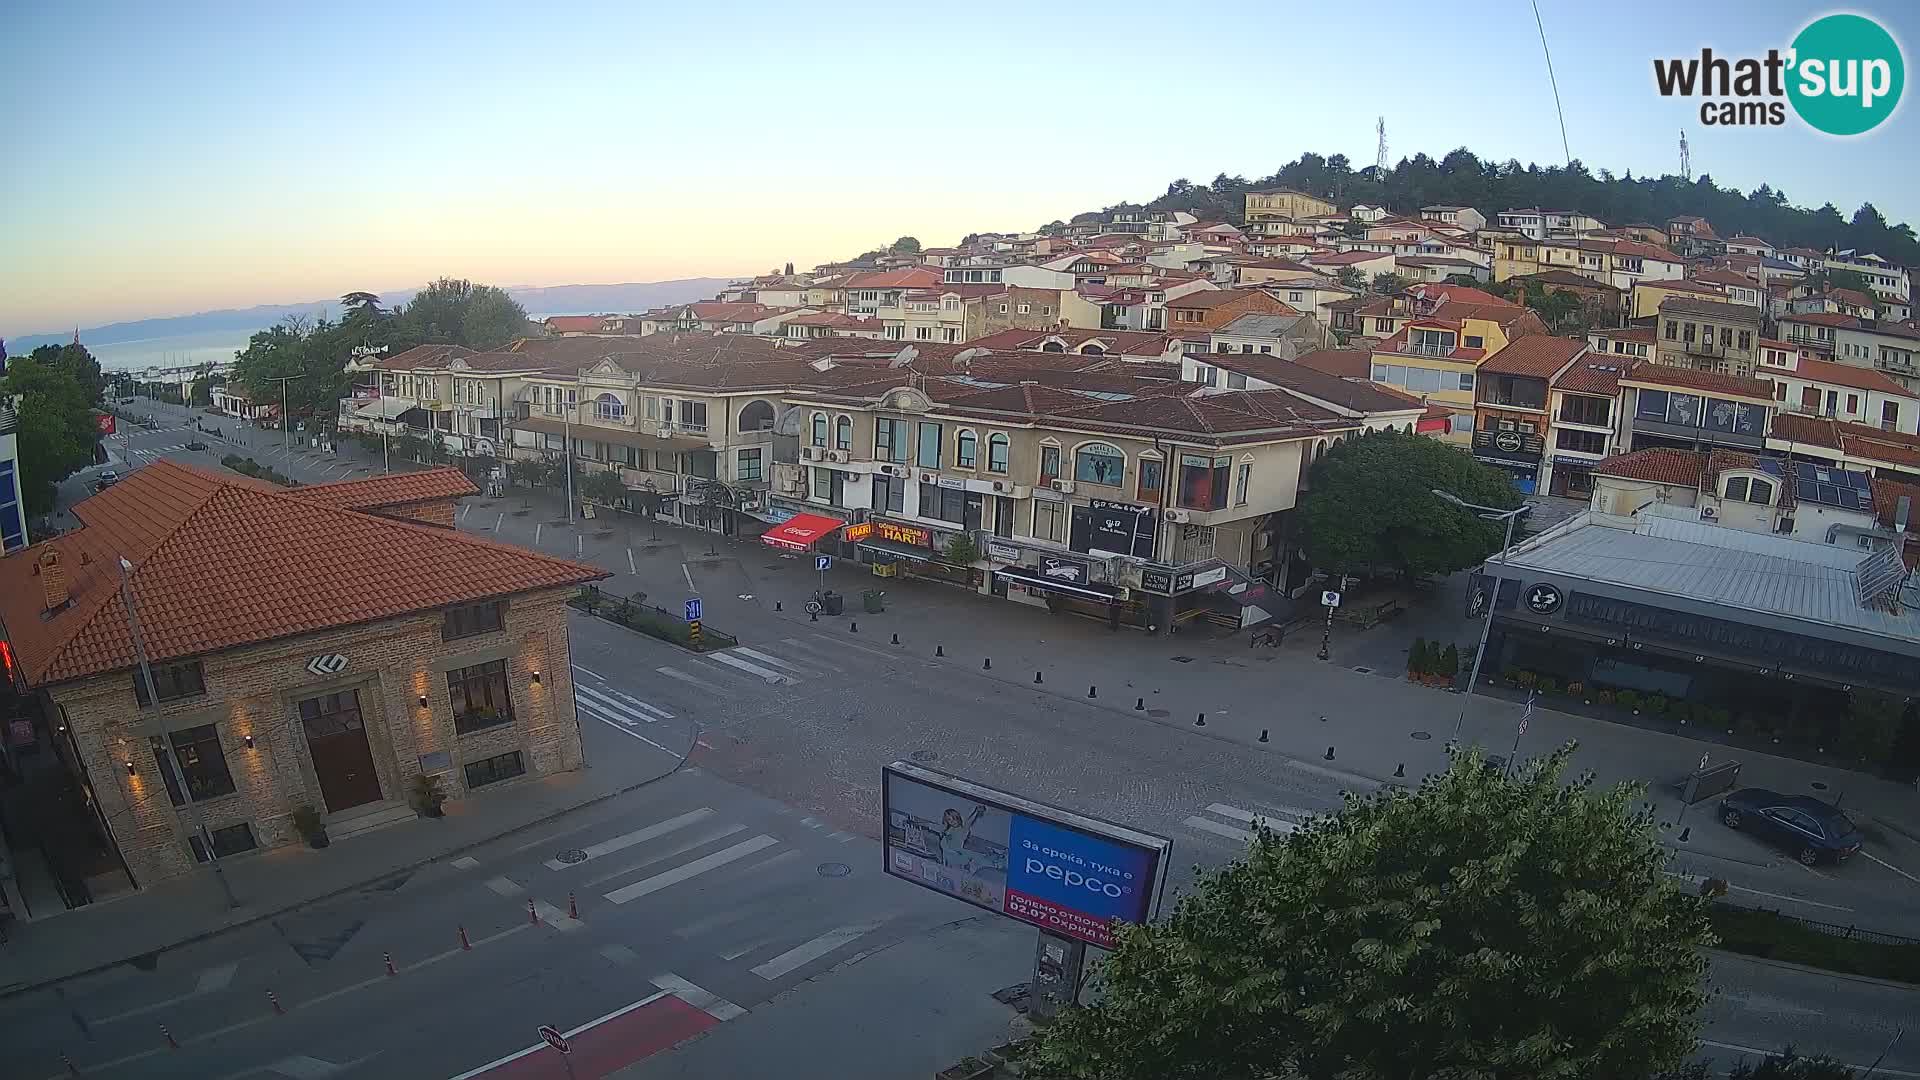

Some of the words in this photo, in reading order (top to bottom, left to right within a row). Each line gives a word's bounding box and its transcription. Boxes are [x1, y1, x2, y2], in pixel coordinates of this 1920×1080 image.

[884, 529, 916, 545] HARI
[820, 558, 827, 568] P
[1022, 840, 1039, 851] За
[1090, 861, 1121, 877] тука
[1123, 872, 1133, 880] е
[1026, 858, 1122, 897] pepco
[1009, 902, 1047, 920] 02.07
[1049, 915, 1097, 939] Охрид
[541, 1030, 567, 1049] STOP
